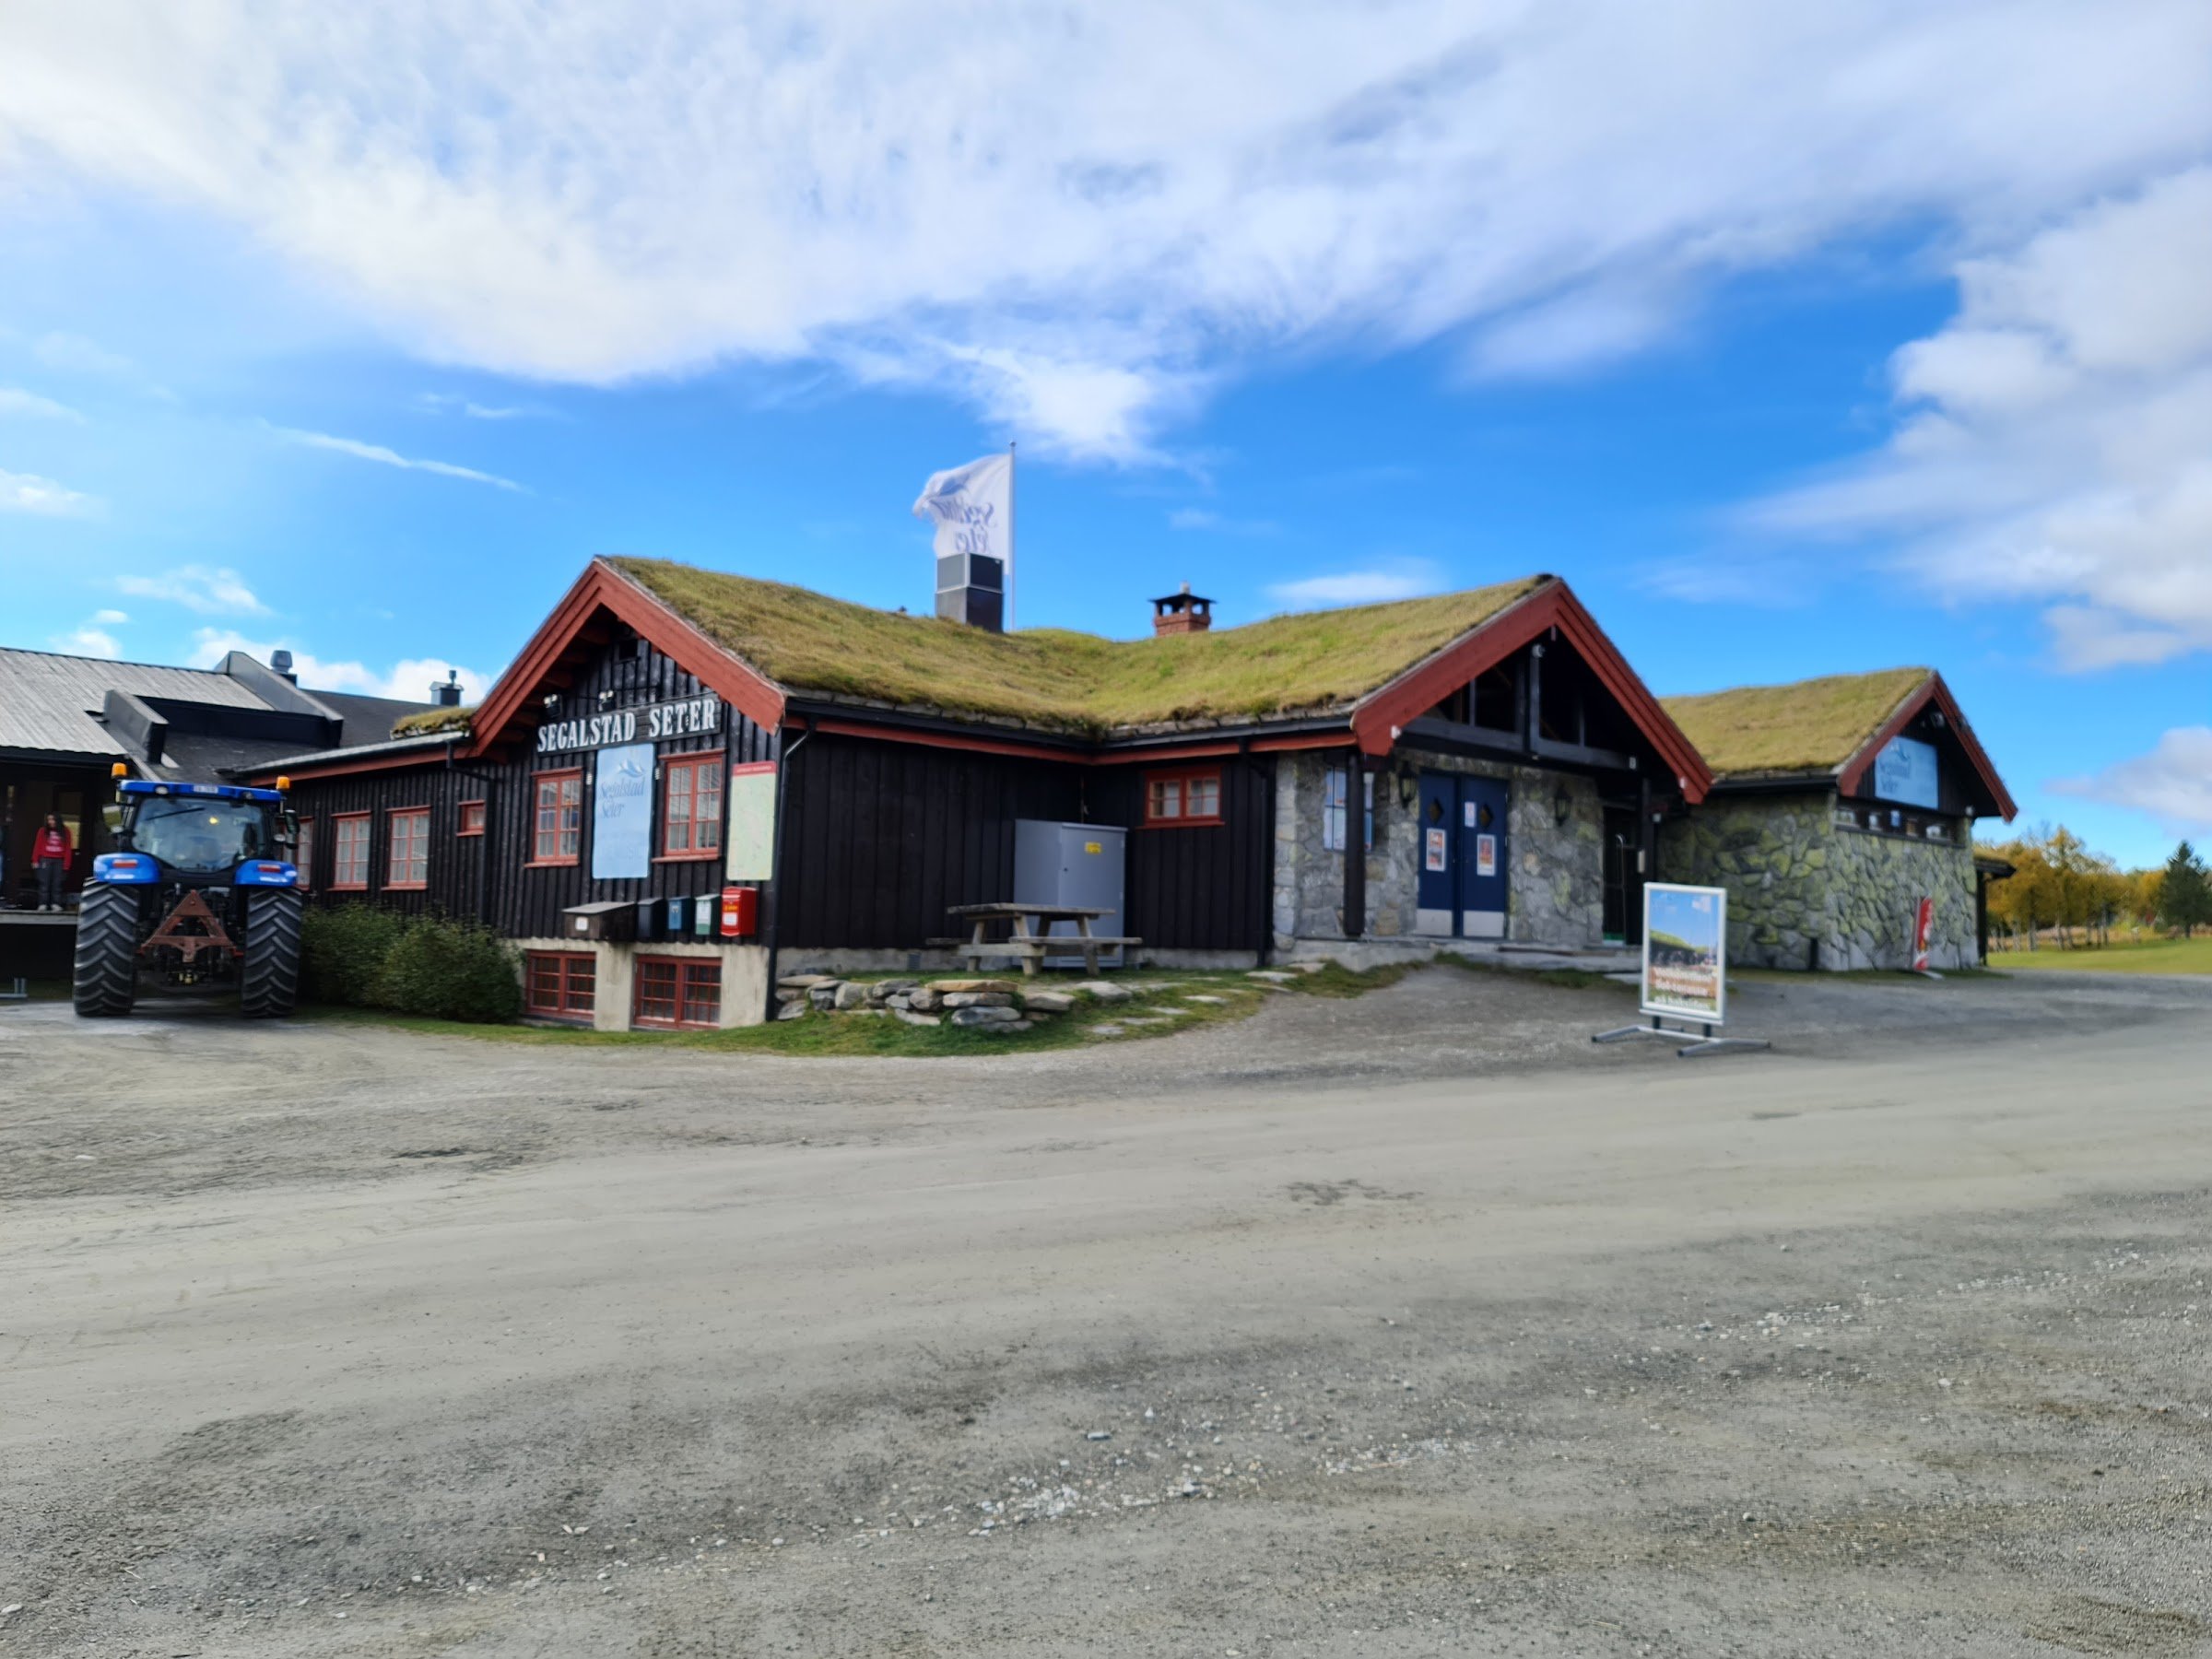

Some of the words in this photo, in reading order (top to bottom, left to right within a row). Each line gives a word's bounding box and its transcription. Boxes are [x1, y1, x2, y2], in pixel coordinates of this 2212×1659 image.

[537, 712, 636, 752] SEGALSTAD
[649, 699, 715, 737] SETER
[599, 777, 645, 799] Segalstad
